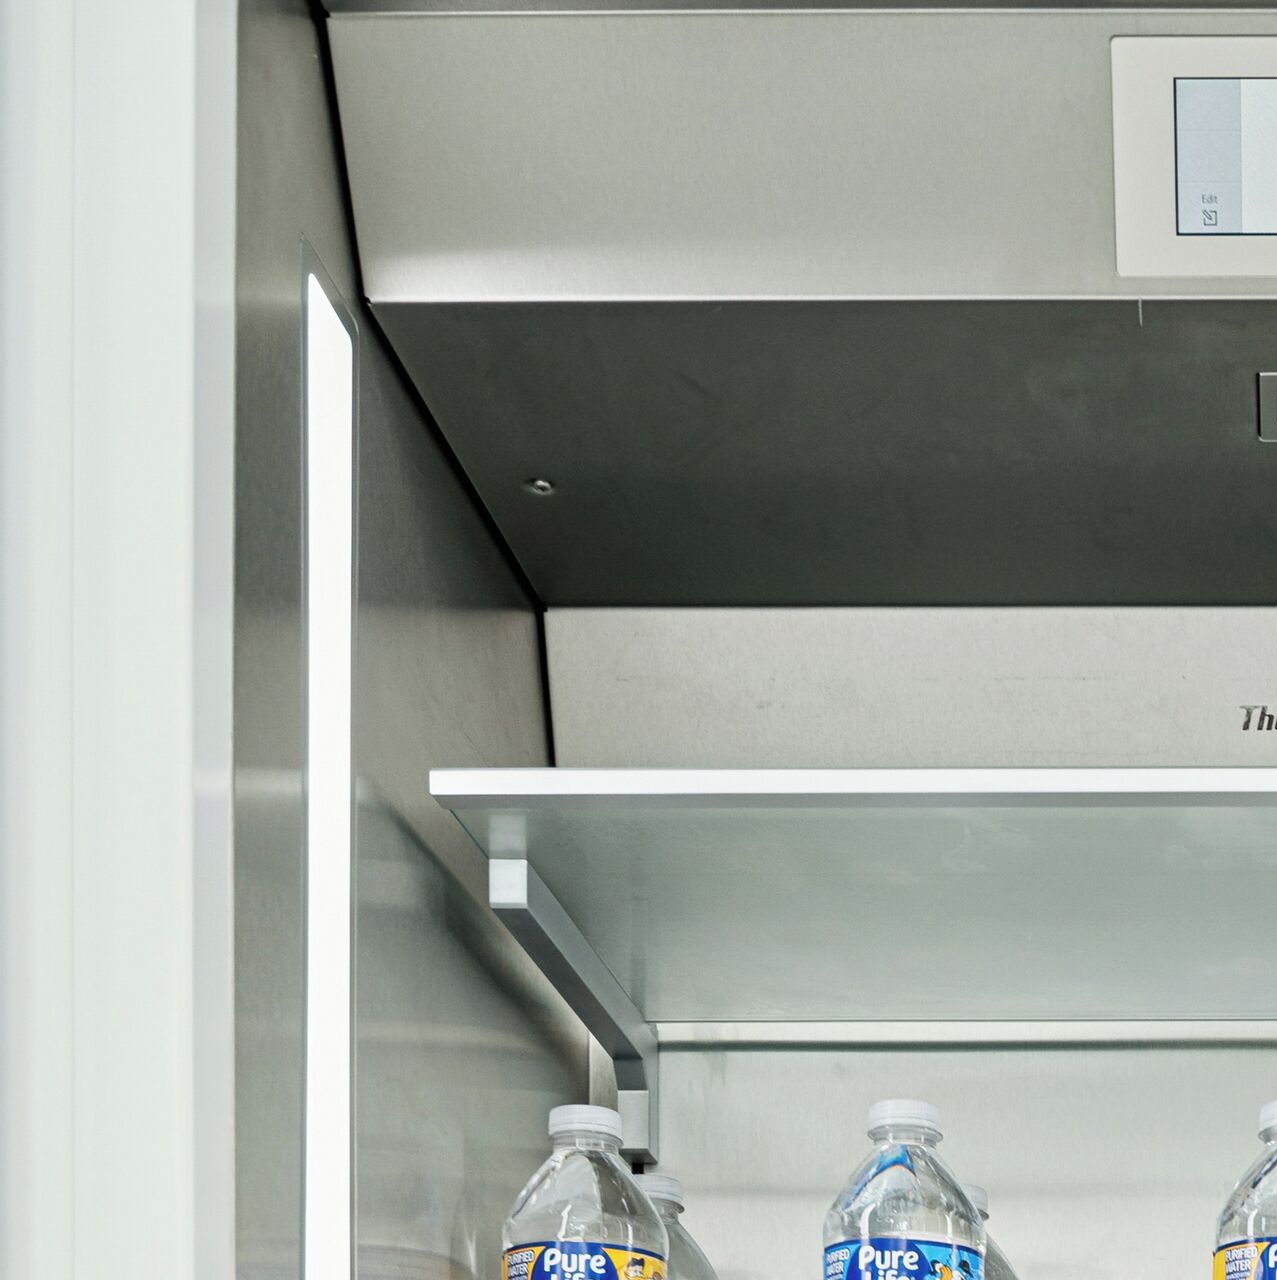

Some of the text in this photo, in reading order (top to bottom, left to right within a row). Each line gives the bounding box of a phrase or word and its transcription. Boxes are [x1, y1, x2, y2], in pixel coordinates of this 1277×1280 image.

[1201, 194, 1218, 204] Edit
[543, 1247, 606, 1274] Pure
[858, 1245, 919, 1272] Pure
[1224, 1246, 1258, 1262] PURIFIED
[1225, 1260, 1252, 1274] WATER
